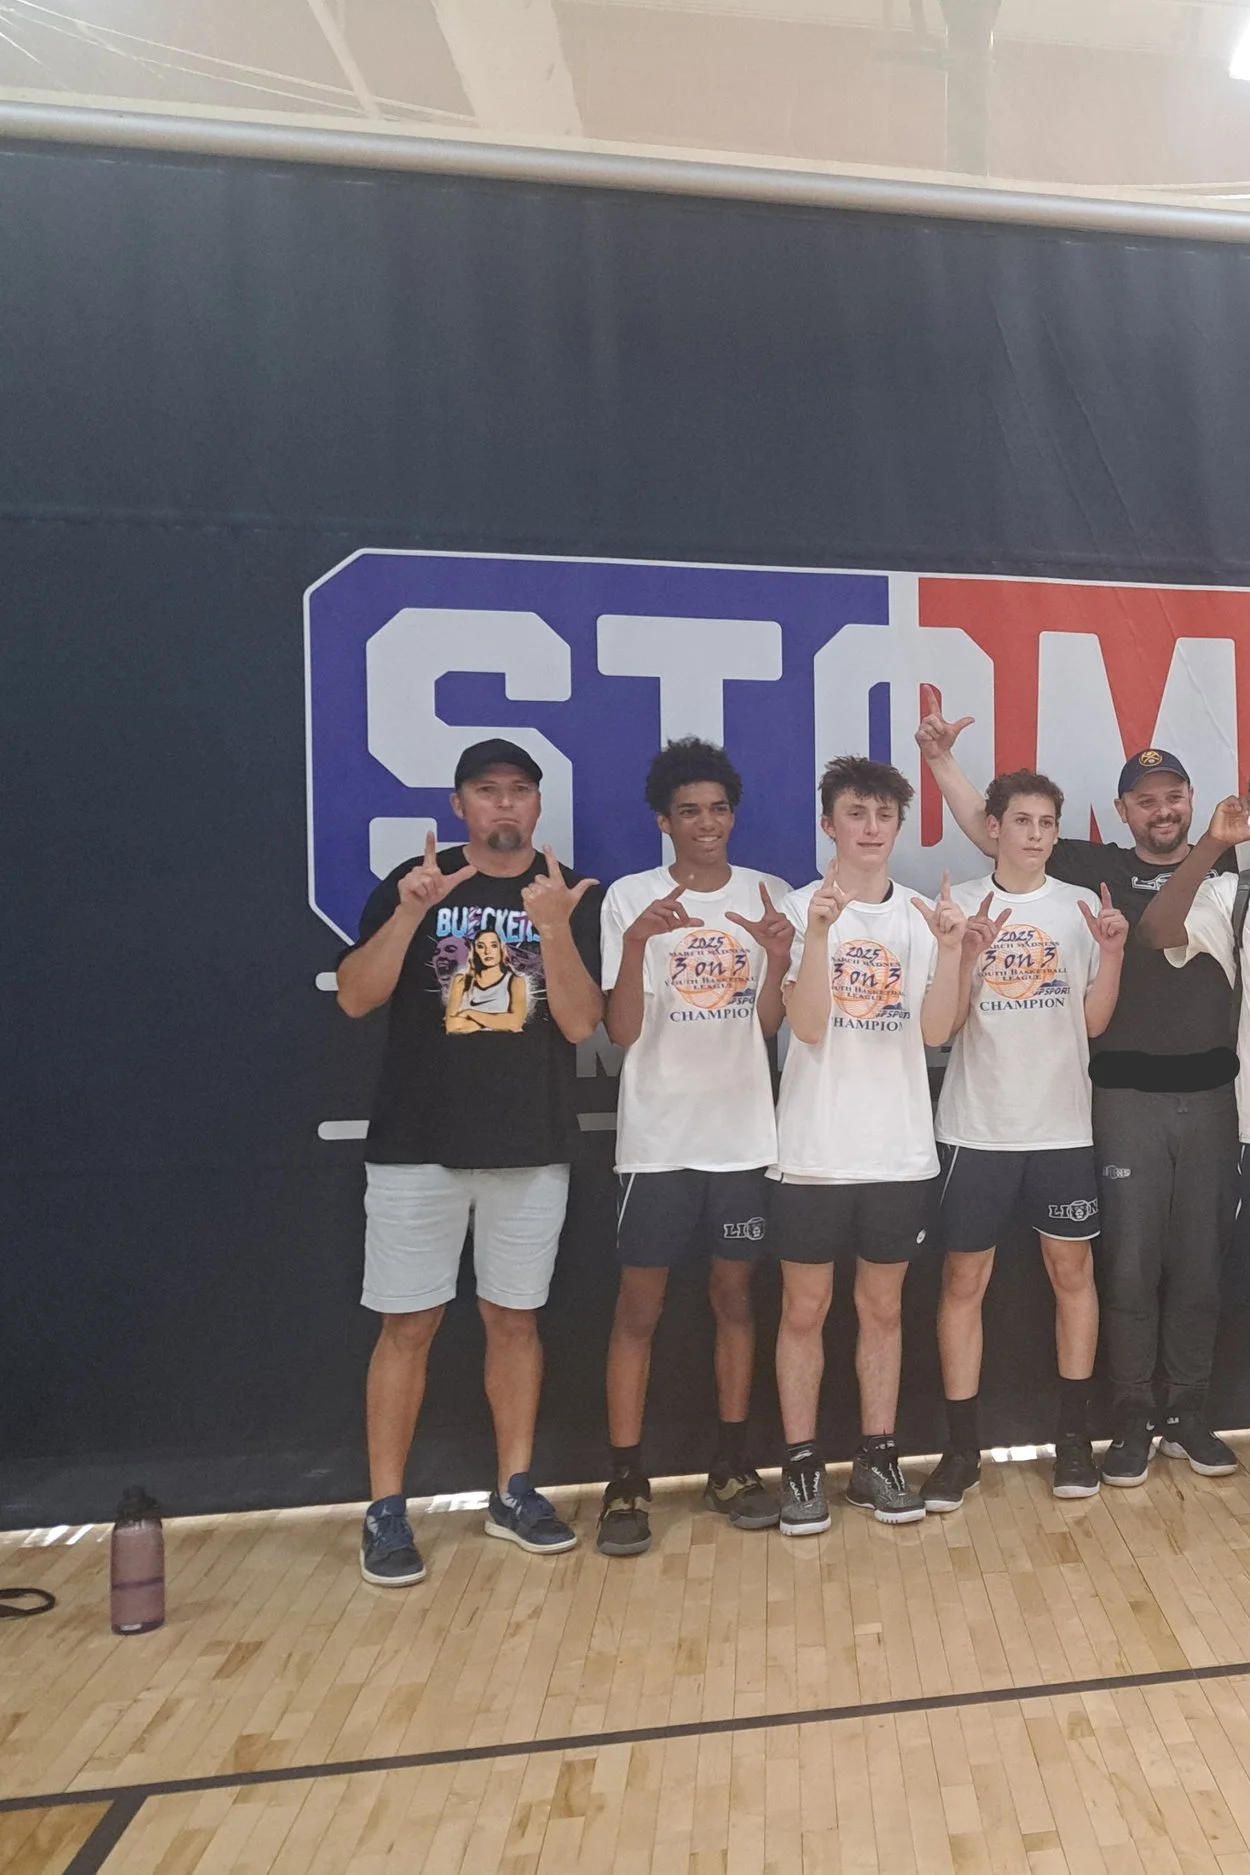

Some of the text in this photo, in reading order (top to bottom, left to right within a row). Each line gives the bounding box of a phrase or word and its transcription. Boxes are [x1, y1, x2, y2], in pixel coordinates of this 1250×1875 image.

[436, 906, 541, 943] BUECKER
[688, 936, 725, 953] 2025
[997, 930, 1036, 944] 2025
[846, 946, 881, 963] 2025
[982, 947, 1056, 972] 3 on 3
[672, 954, 746, 980] 3 on 3
[832, 963, 901, 989] 3 on 3
[980, 997, 1065, 1012] CHAMPION
[832, 1016, 903, 1032] HAMPIO
